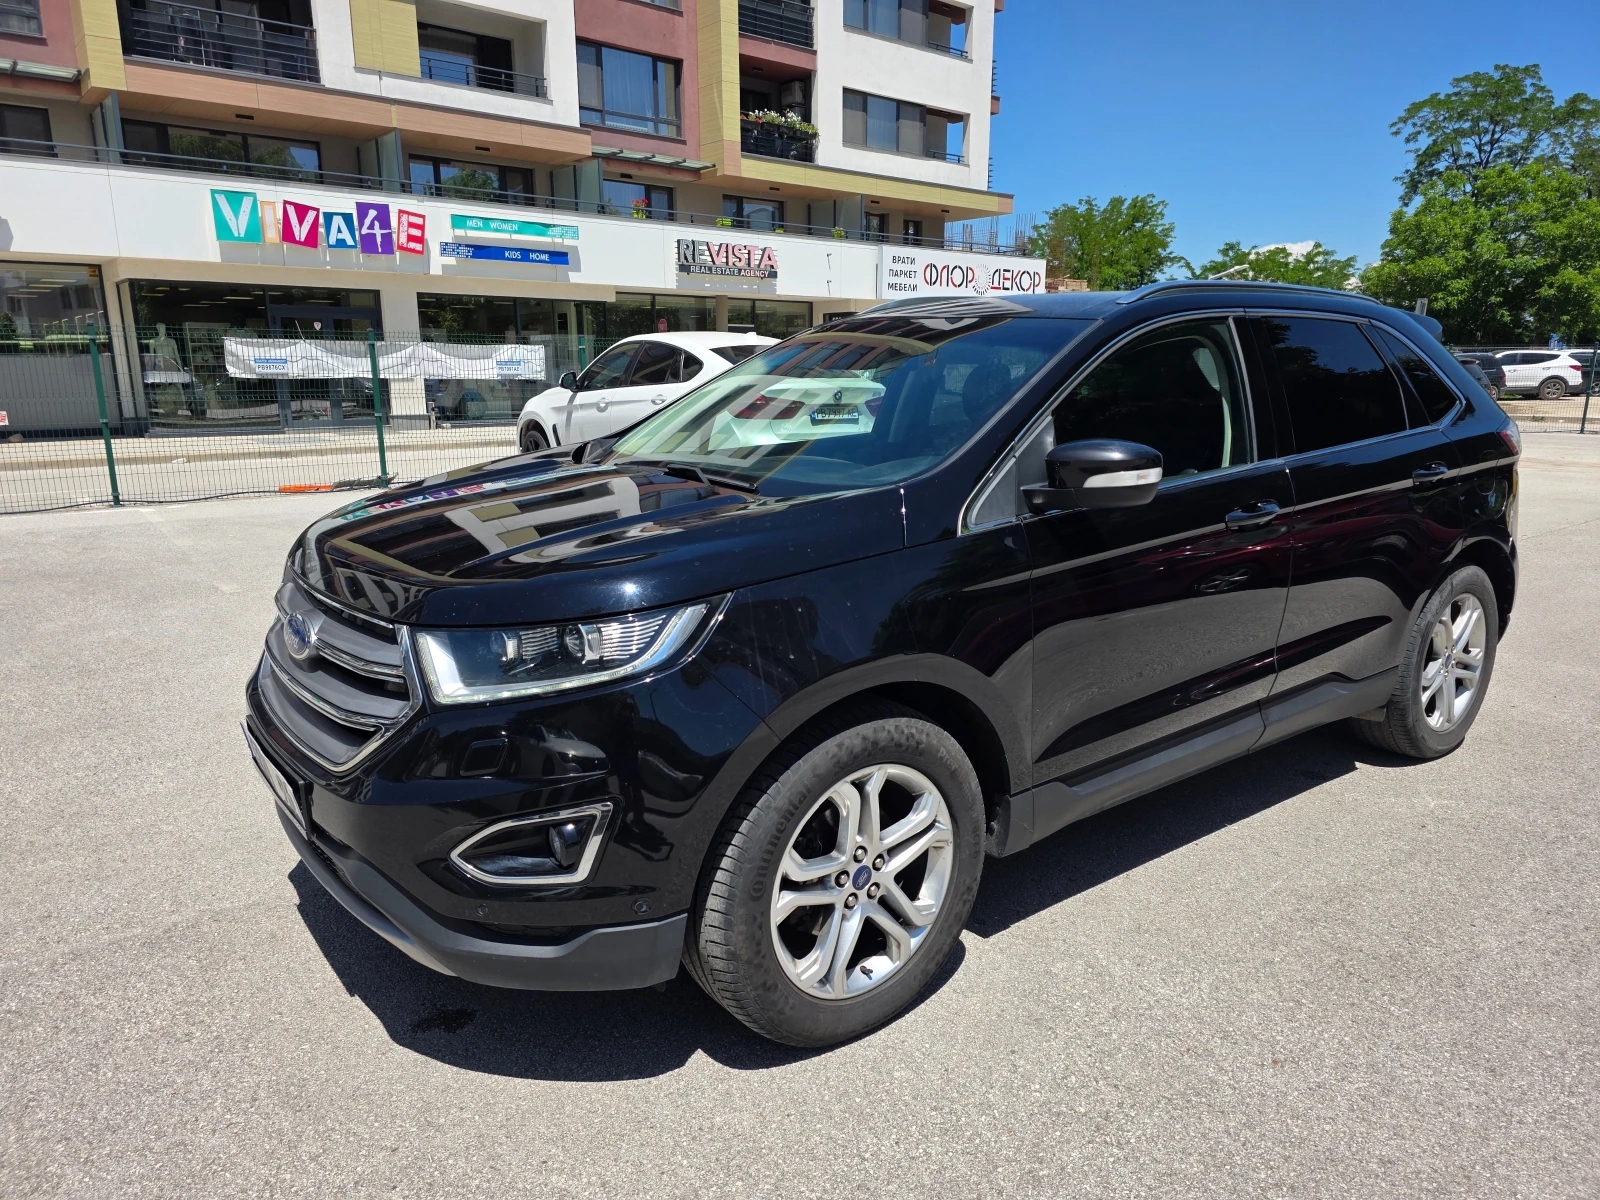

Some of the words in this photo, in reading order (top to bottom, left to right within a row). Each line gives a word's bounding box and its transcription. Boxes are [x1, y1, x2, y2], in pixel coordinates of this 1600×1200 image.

[211, 190, 425, 254] VIVA4E
[466, 219, 483, 228] MEN
[489, 221, 518, 231] WOMEN
[504, 250, 521, 259] KIDS
[529, 252, 550, 261] HOME
[677, 239, 779, 270] REVISTA
[892, 255, 916, 265] ВРАТИ
[690, 265, 710, 273] REAL
[712, 266, 739, 276] ESTATE
[740, 269, 769, 278] AGENCY
[888, 268, 918, 279] ПАРКЕТ
[887, 282, 918, 292] МЕБЕЛИ
